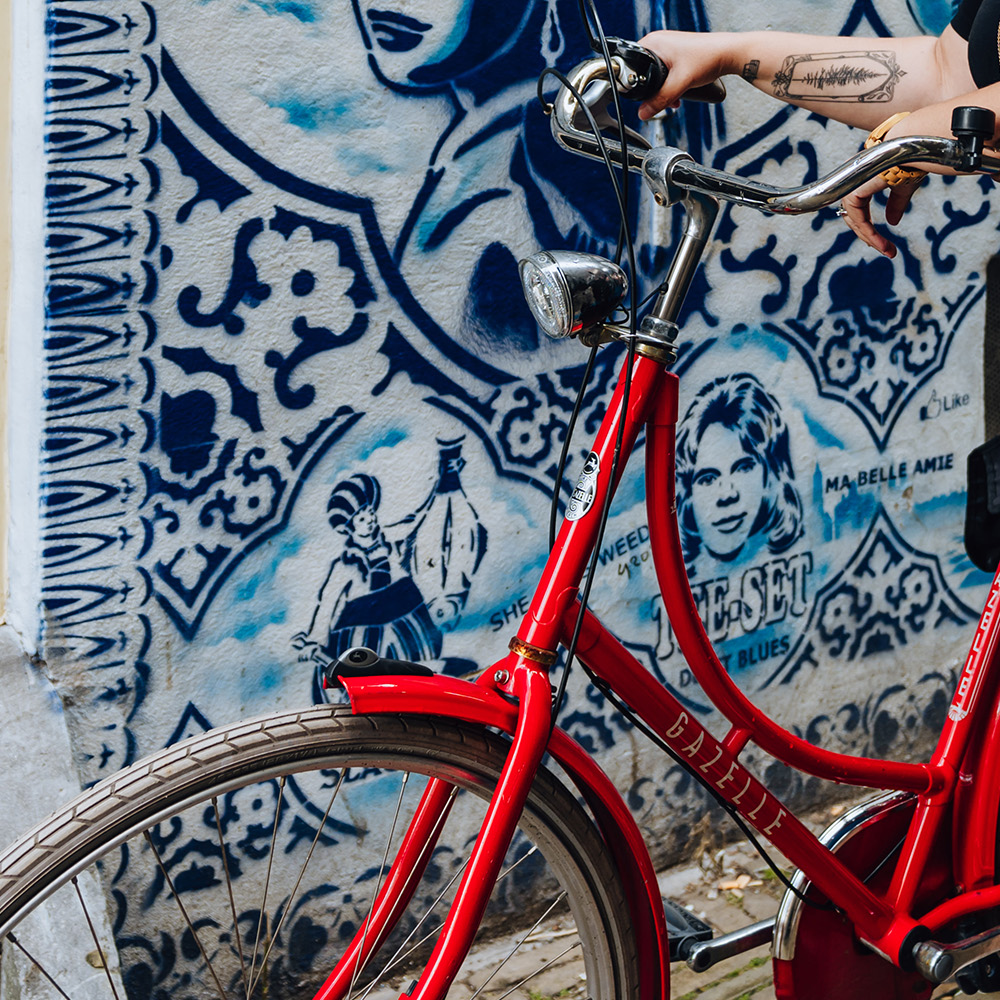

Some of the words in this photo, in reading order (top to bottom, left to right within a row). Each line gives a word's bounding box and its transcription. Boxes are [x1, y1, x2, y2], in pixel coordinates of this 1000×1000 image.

[943, 393, 970, 412] Like
[825, 474, 851, 493] MA
[857, 463, 907, 487] BELLE
[913, 453, 954, 475] AMIE
[598, 525, 650, 567] WEED
[489, 595, 530, 633] SHE
[738, 635, 790, 668] BLUES
[665, 711, 787, 836] GAZELLE
